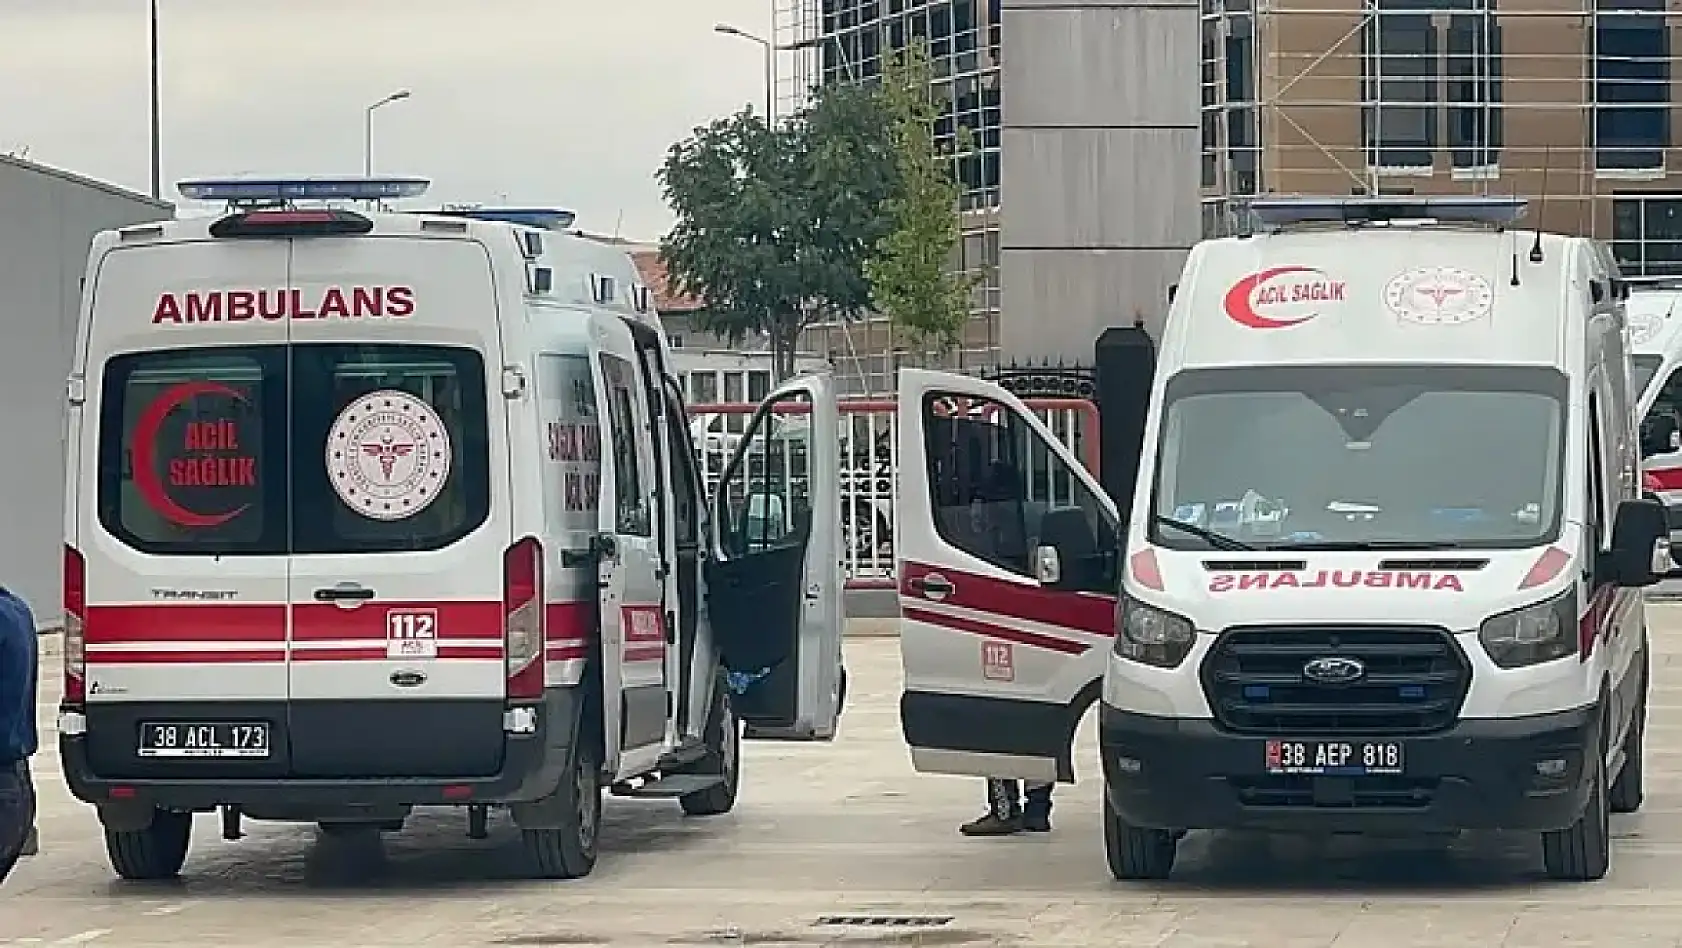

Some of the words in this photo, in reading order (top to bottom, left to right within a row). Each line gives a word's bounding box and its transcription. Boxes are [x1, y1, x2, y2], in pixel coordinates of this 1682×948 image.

[151, 287, 415, 324] AMBULANS
[184, 418, 238, 450] ACİL
[170, 454, 255, 486] SAĞLIK
[391, 614, 434, 638] 112
[985, 644, 1009, 666] 112
[154, 726, 177, 747] 38
[184, 726, 222, 747] ACL
[231, 726, 265, 747] 173
[1282, 743, 1306, 766] 38
[1315, 743, 1353, 766] AEP
